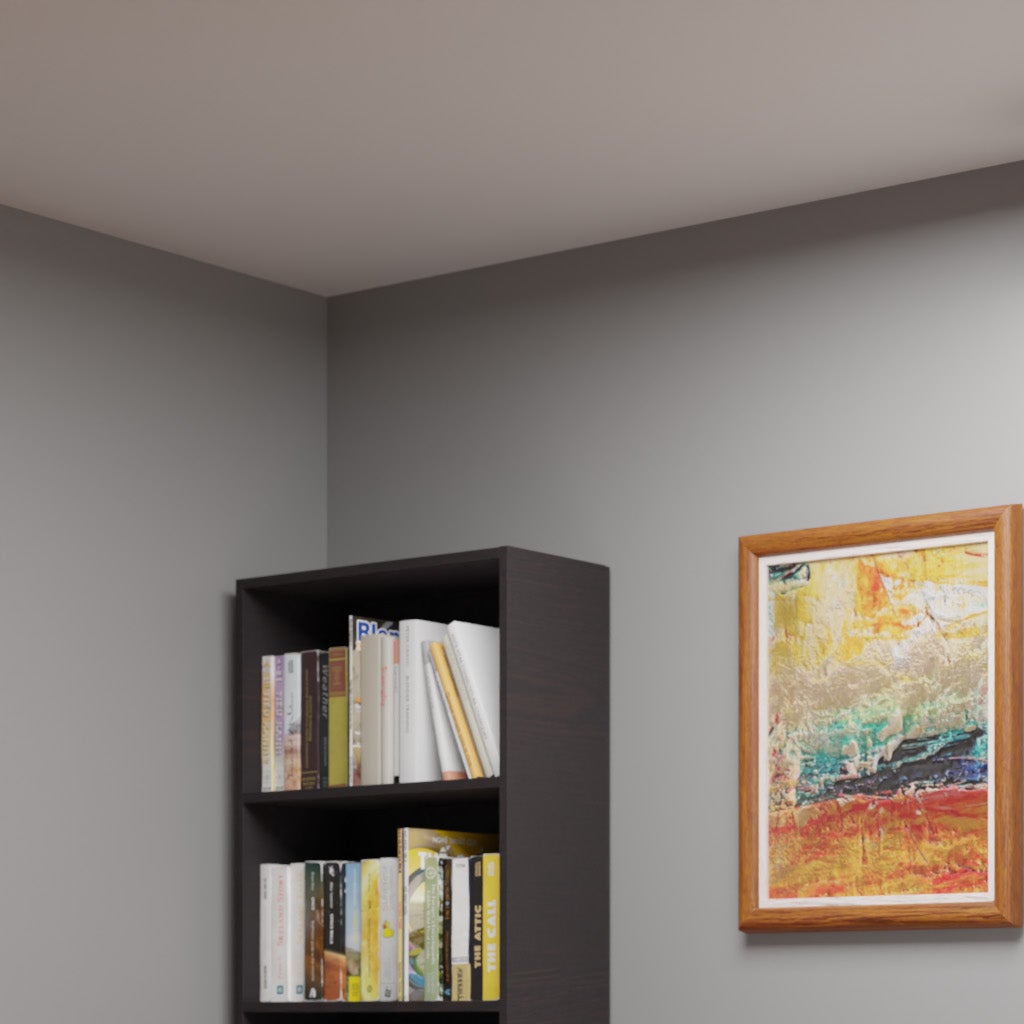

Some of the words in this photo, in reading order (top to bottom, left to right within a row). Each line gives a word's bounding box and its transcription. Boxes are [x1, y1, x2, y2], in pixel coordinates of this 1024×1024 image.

[474, 905, 482, 941] ATTIC
[487, 899, 497, 939] CALL
[474, 945, 482, 969] THE
[487, 943, 497, 973] THE
